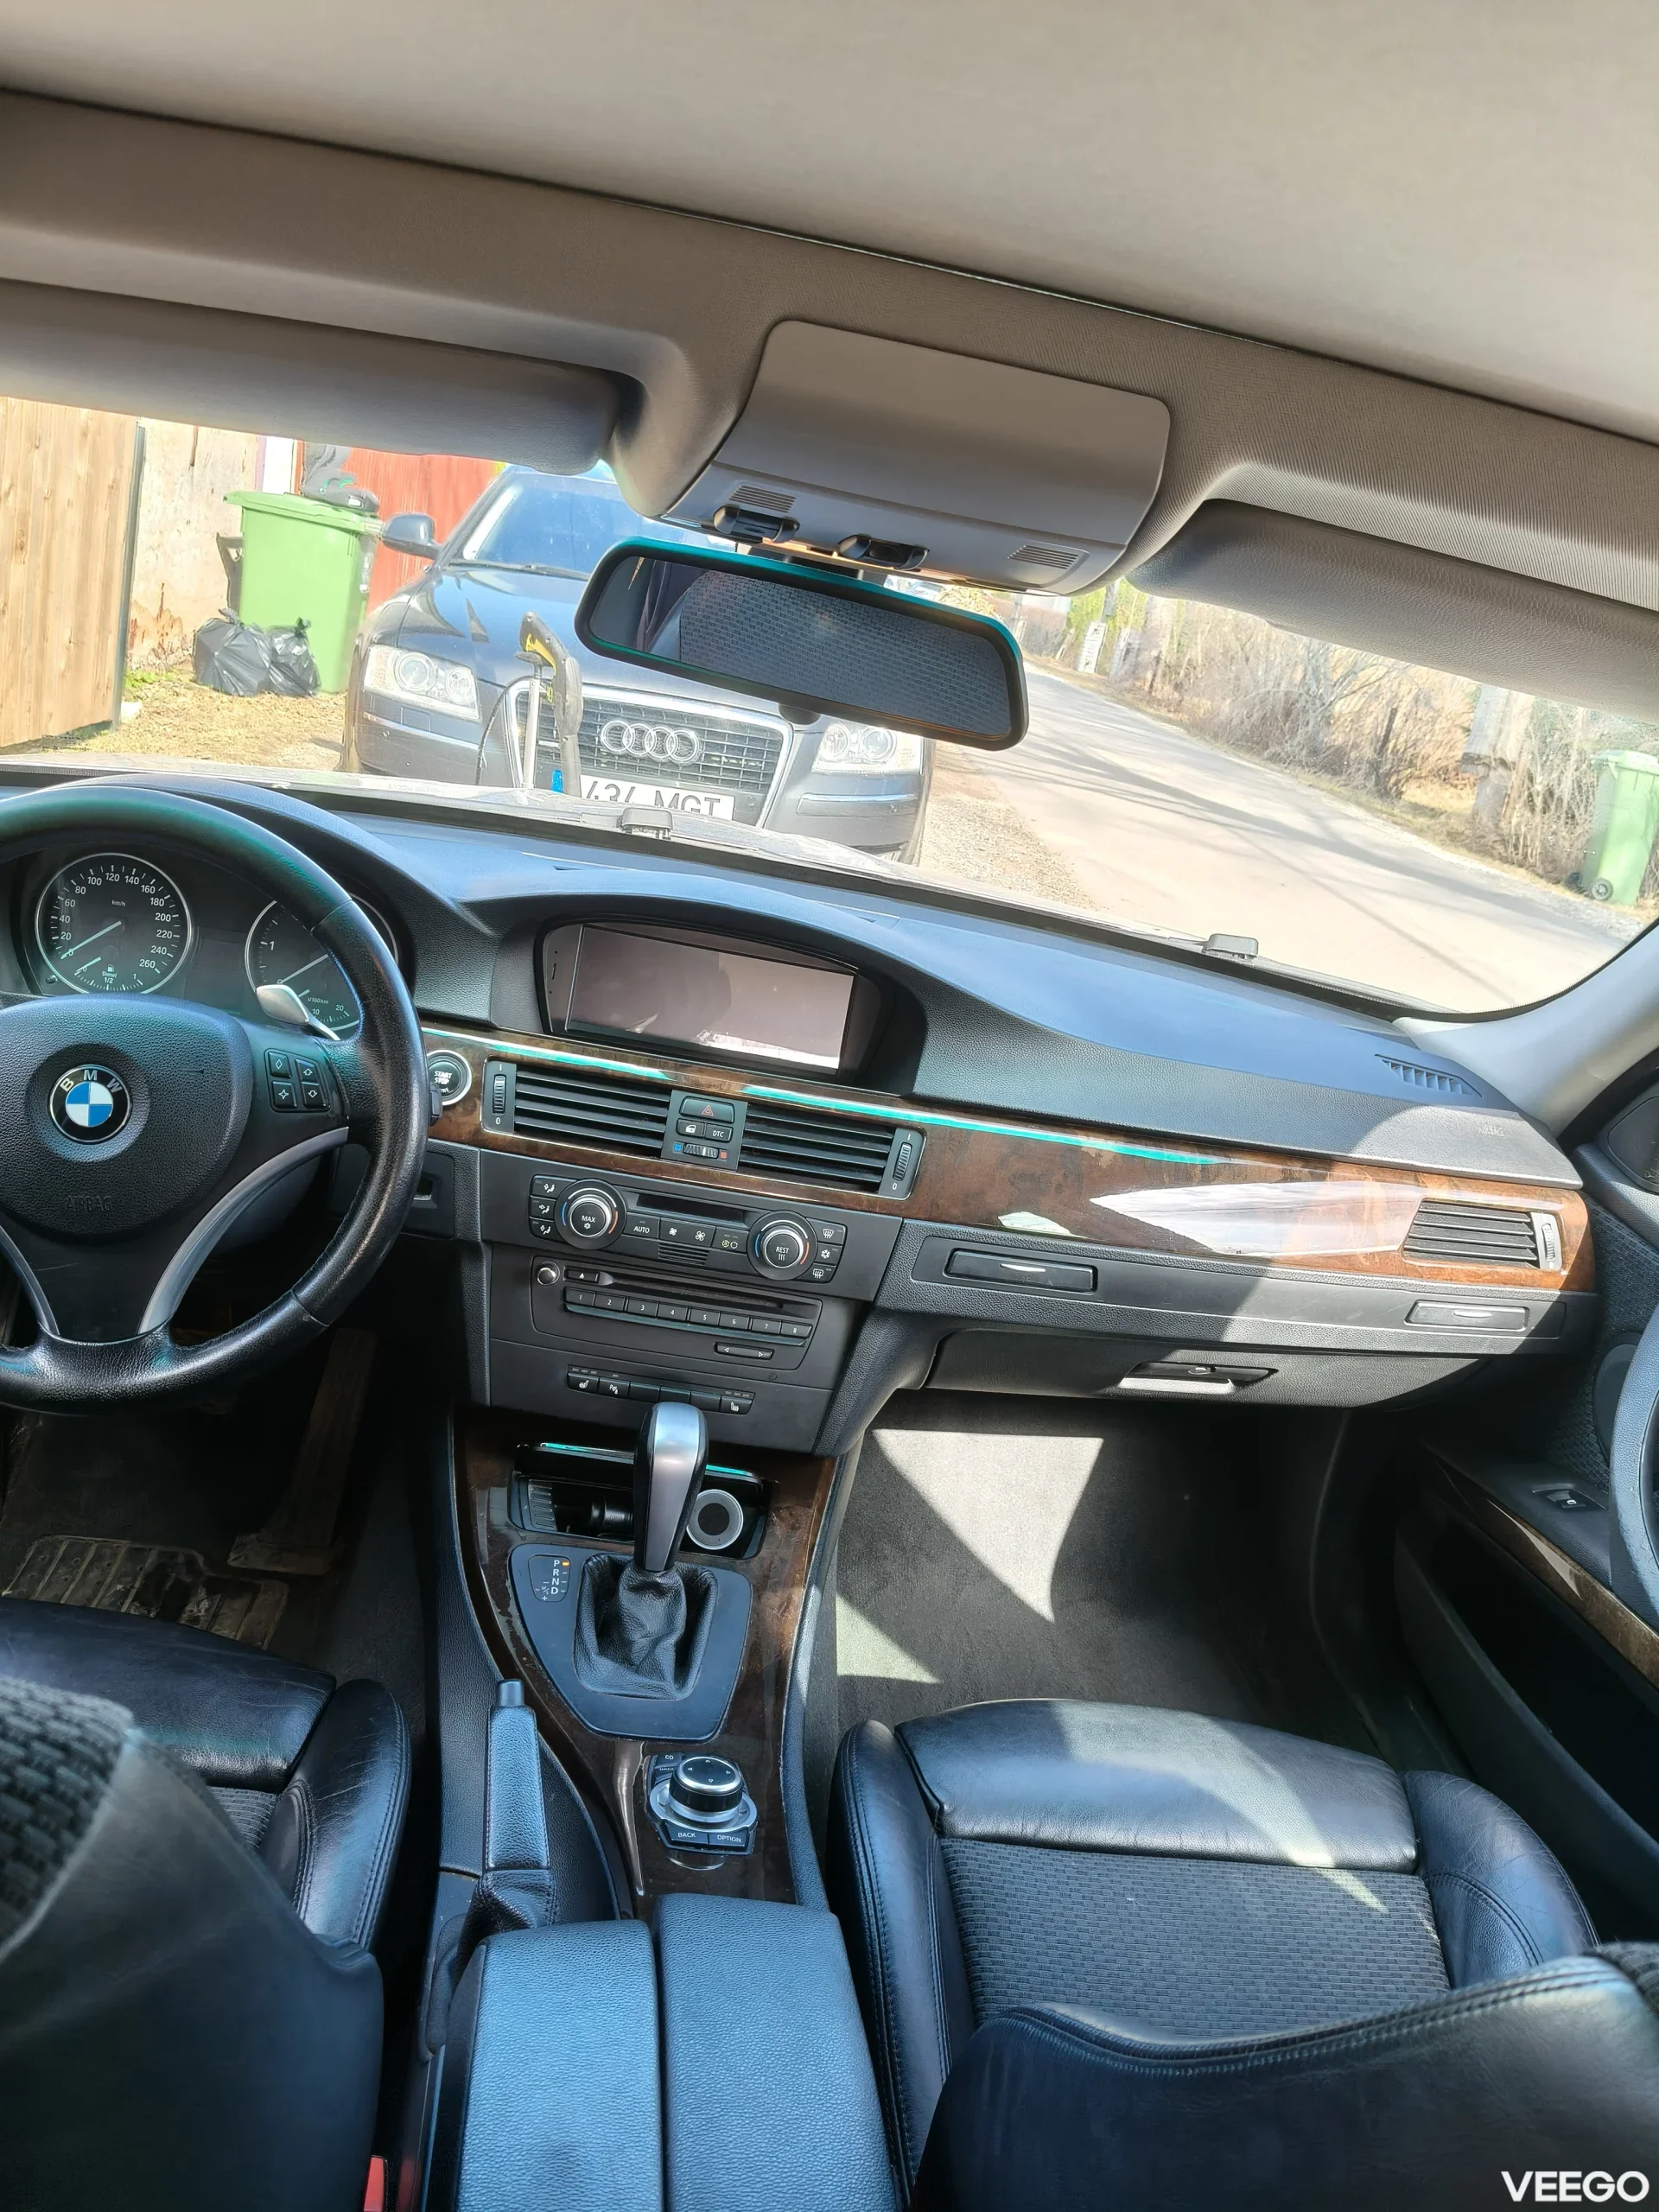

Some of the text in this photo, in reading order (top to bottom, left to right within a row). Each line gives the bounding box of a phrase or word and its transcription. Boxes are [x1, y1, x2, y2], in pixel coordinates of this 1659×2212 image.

[654, 790, 721, 817] MGT
[87, 876, 102, 887] 100
[105, 872, 120, 882] 120
[124, 875, 140, 885] 140
[74, 886, 86, 895] 80
[141, 885, 156, 894] 160
[64, 899, 76, 908] 60
[149, 897, 165, 907] 180
[59, 914, 71, 924] 40
[155, 912, 171, 922] 200
[60, 931, 72, 941] 20
[156, 929, 173, 939] 220
[150, 944, 167, 955] 240
[270, 940, 275, 951] 1
[139, 958, 156, 969] 260
[434, 1070, 453, 1079] START
[60, 1069, 124, 1094] BMW
[434, 1077, 450, 1085] STOP
[712, 1129, 724, 1139] DTC
[67, 1196, 112, 1211] AIRBAG
[581, 1214, 596, 1224] MAX
[633, 1225, 650, 1235] AUTO
[776, 1245, 790, 1255] REST
[716, 1834, 741, 1843] OPTION
